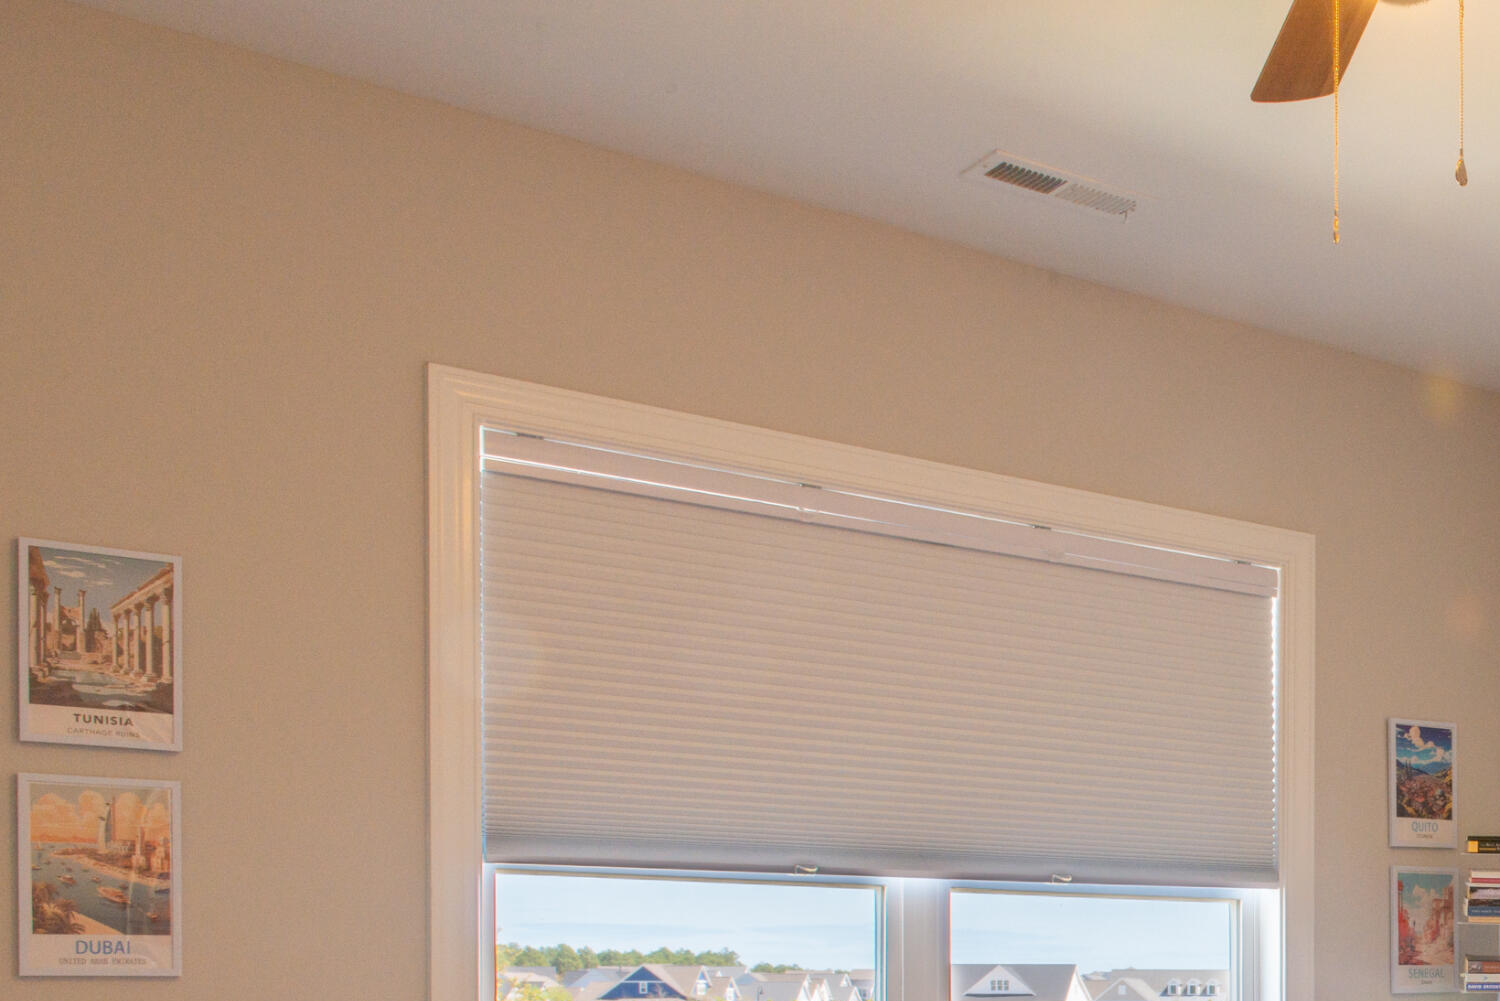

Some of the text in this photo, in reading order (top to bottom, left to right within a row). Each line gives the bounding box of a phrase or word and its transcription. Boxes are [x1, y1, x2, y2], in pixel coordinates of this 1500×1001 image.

[73, 713, 134, 726] TUNISIA
[1411, 821, 1439, 833] QUITO
[75, 940, 131, 955] DUBAI
[1408, 967, 1445, 979] SENEGAL
